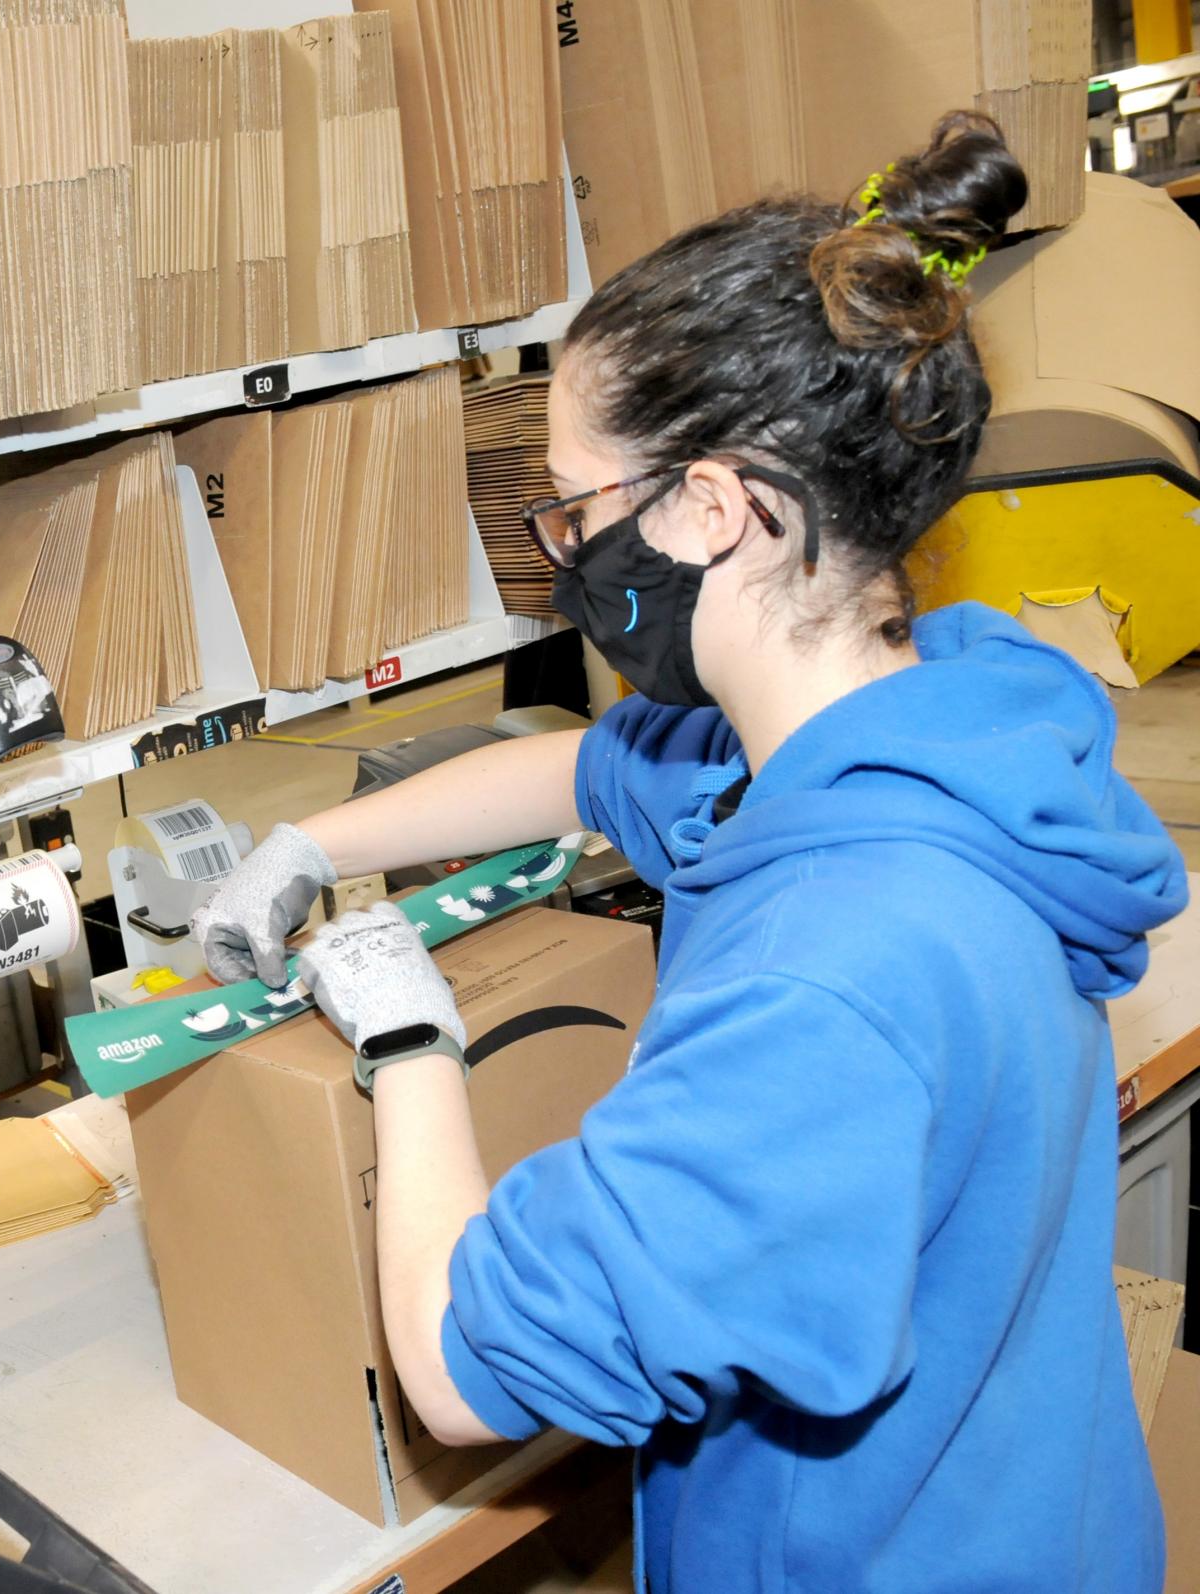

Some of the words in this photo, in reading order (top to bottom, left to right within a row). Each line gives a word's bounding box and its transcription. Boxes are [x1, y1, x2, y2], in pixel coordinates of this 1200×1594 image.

[557, 0, 579, 48] M4
[464, 330, 479, 350] E3
[255, 377, 273, 394] E0
[206, 473, 224, 519] M2
[372, 663, 395, 684] M2
[202, 718, 215, 750] ime
[97, 1033, 163, 1061] amazon
